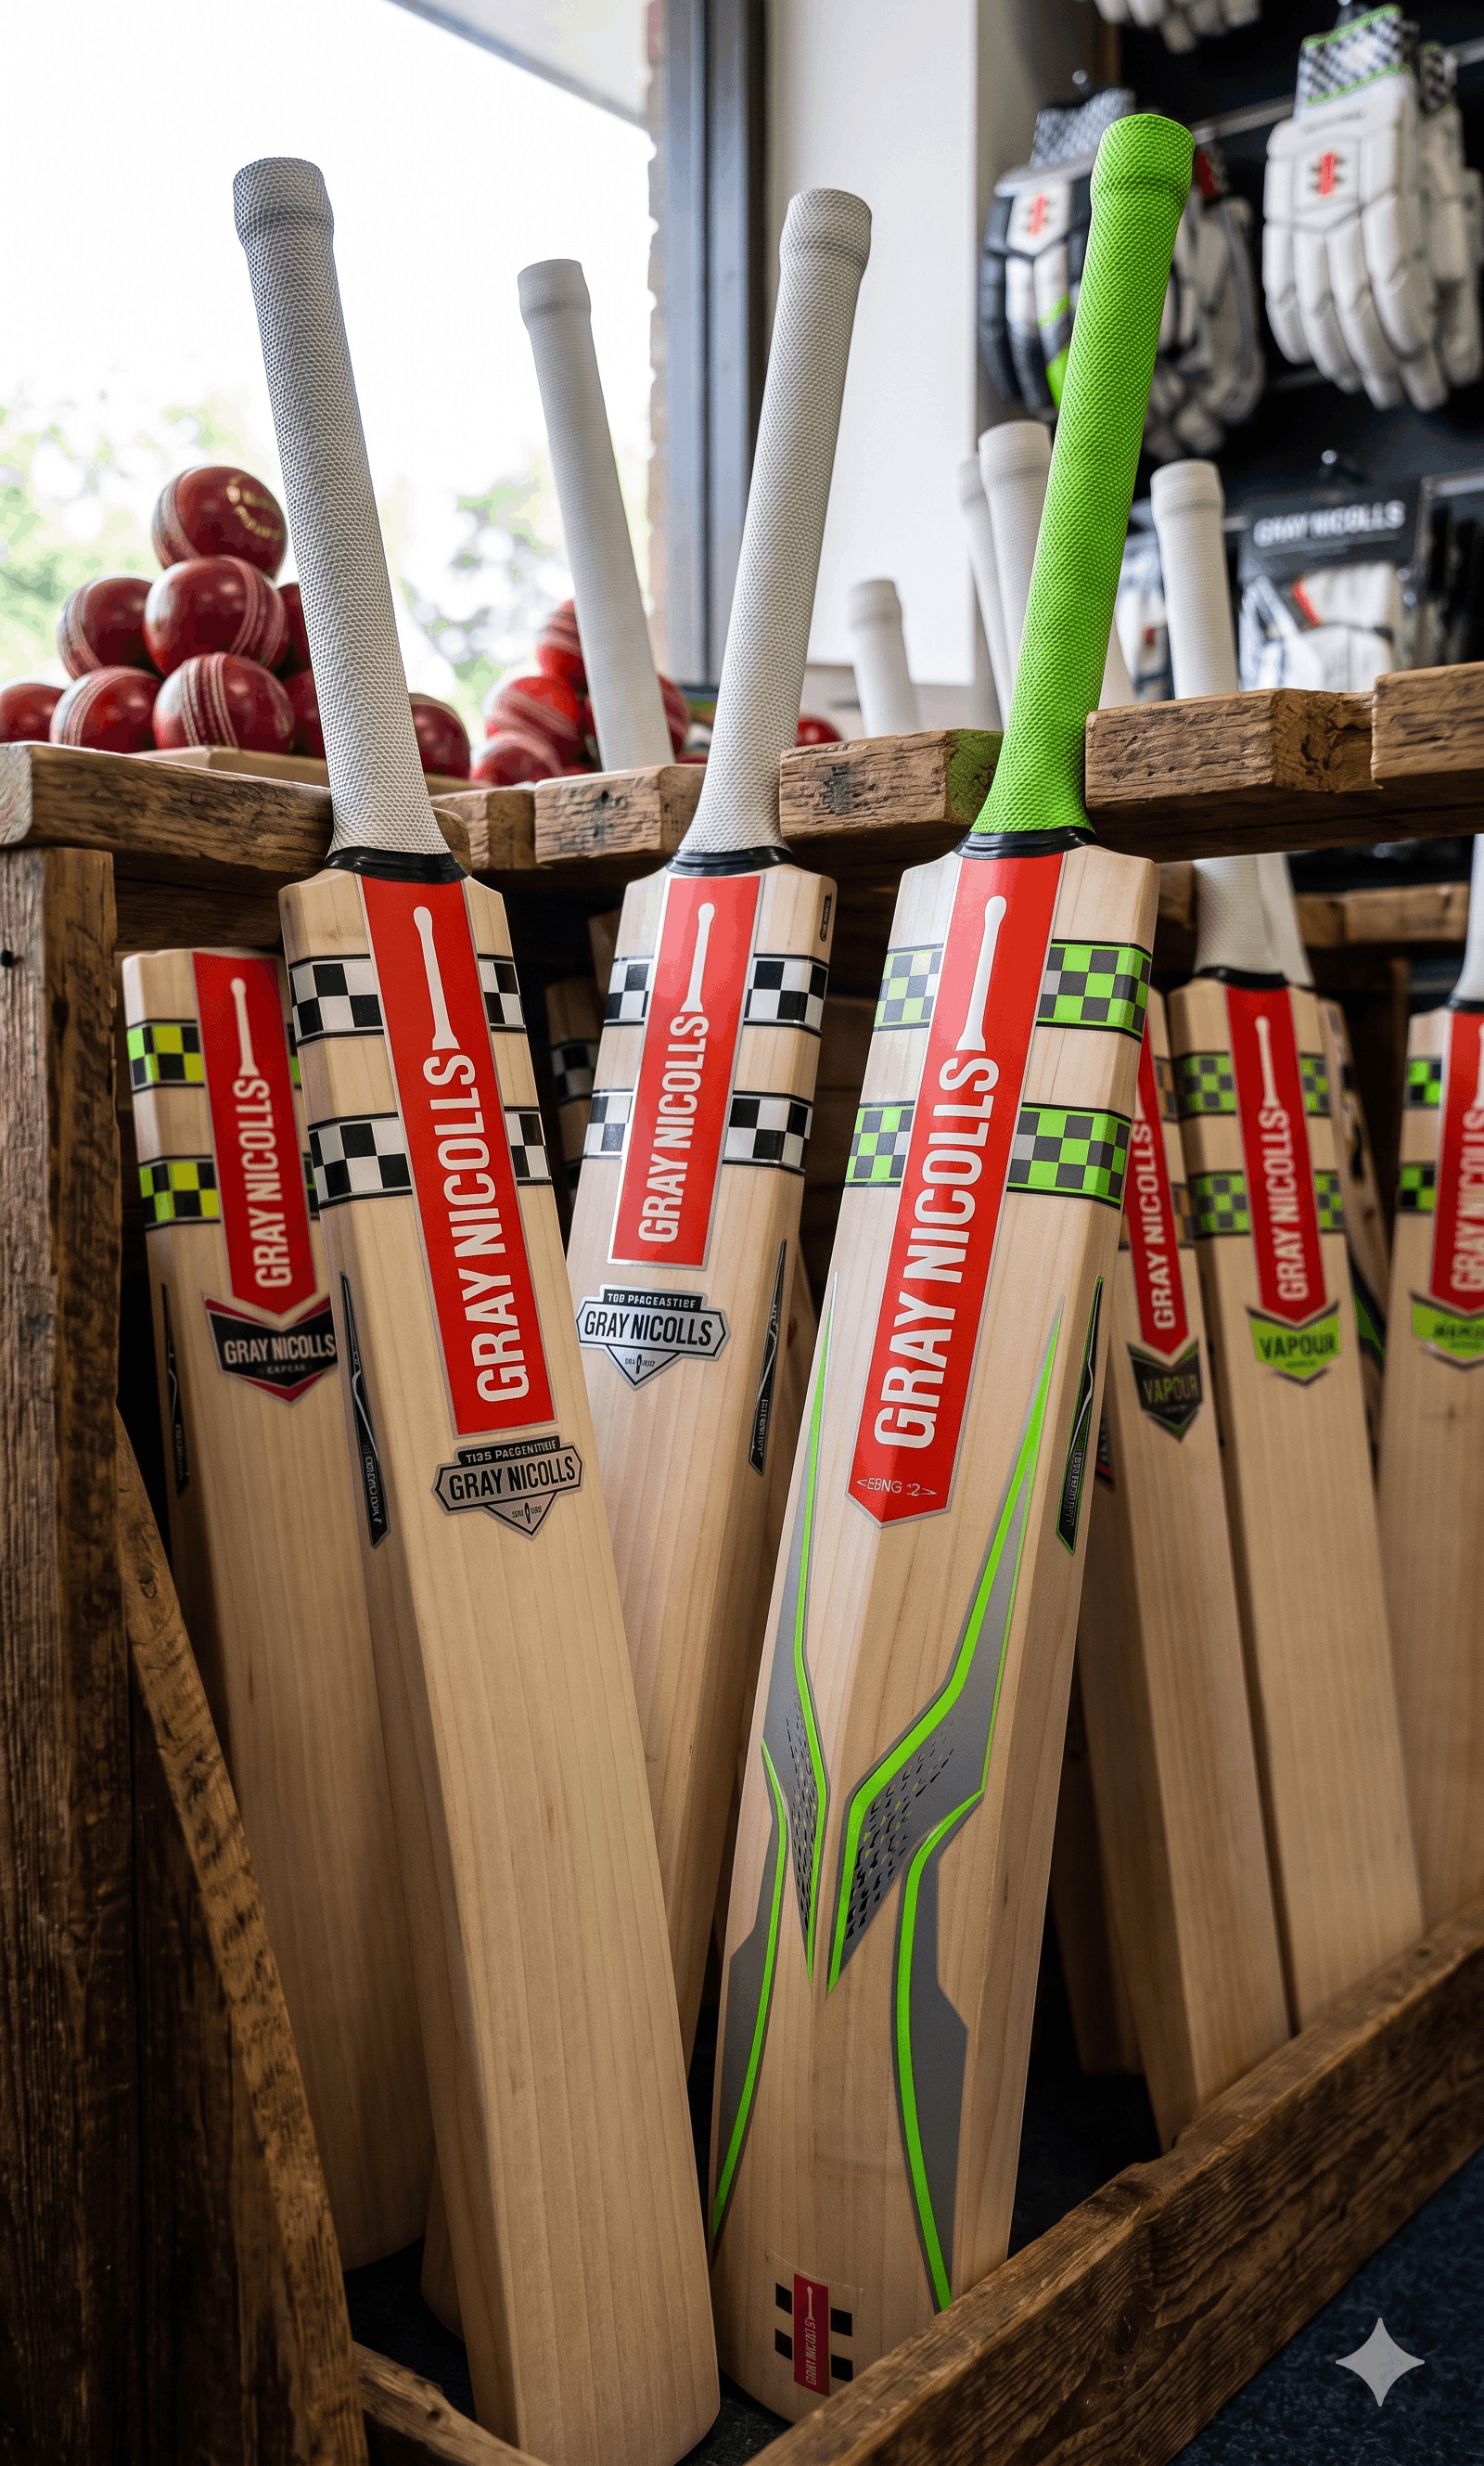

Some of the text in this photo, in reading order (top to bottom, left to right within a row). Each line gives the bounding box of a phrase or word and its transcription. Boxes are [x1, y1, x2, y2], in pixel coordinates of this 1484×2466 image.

[233, 1078, 293, 1288] GRAY NICOLLS
[638, 1015, 710, 1243] GRAY NICOLLS
[1258, 1109, 1310, 1301] GRAY NICOLLS
[422, 1054, 530, 1403] GRAY NICOLLS
[873, 1058, 1000, 1448] GRAY NICOLLS
[1132, 1123, 1176, 1329] GRAY NICOLLS
[224, 1333, 337, 1364] GRAY NICOLLS
[584, 1310, 713, 1346] GRAY NICOLLS
[1143, 1374, 1198, 1404] VAPOUR
[1259, 1332, 1337, 1358] VAPOUR
[449, 1456, 576, 1501] GRAY NICOLLS
